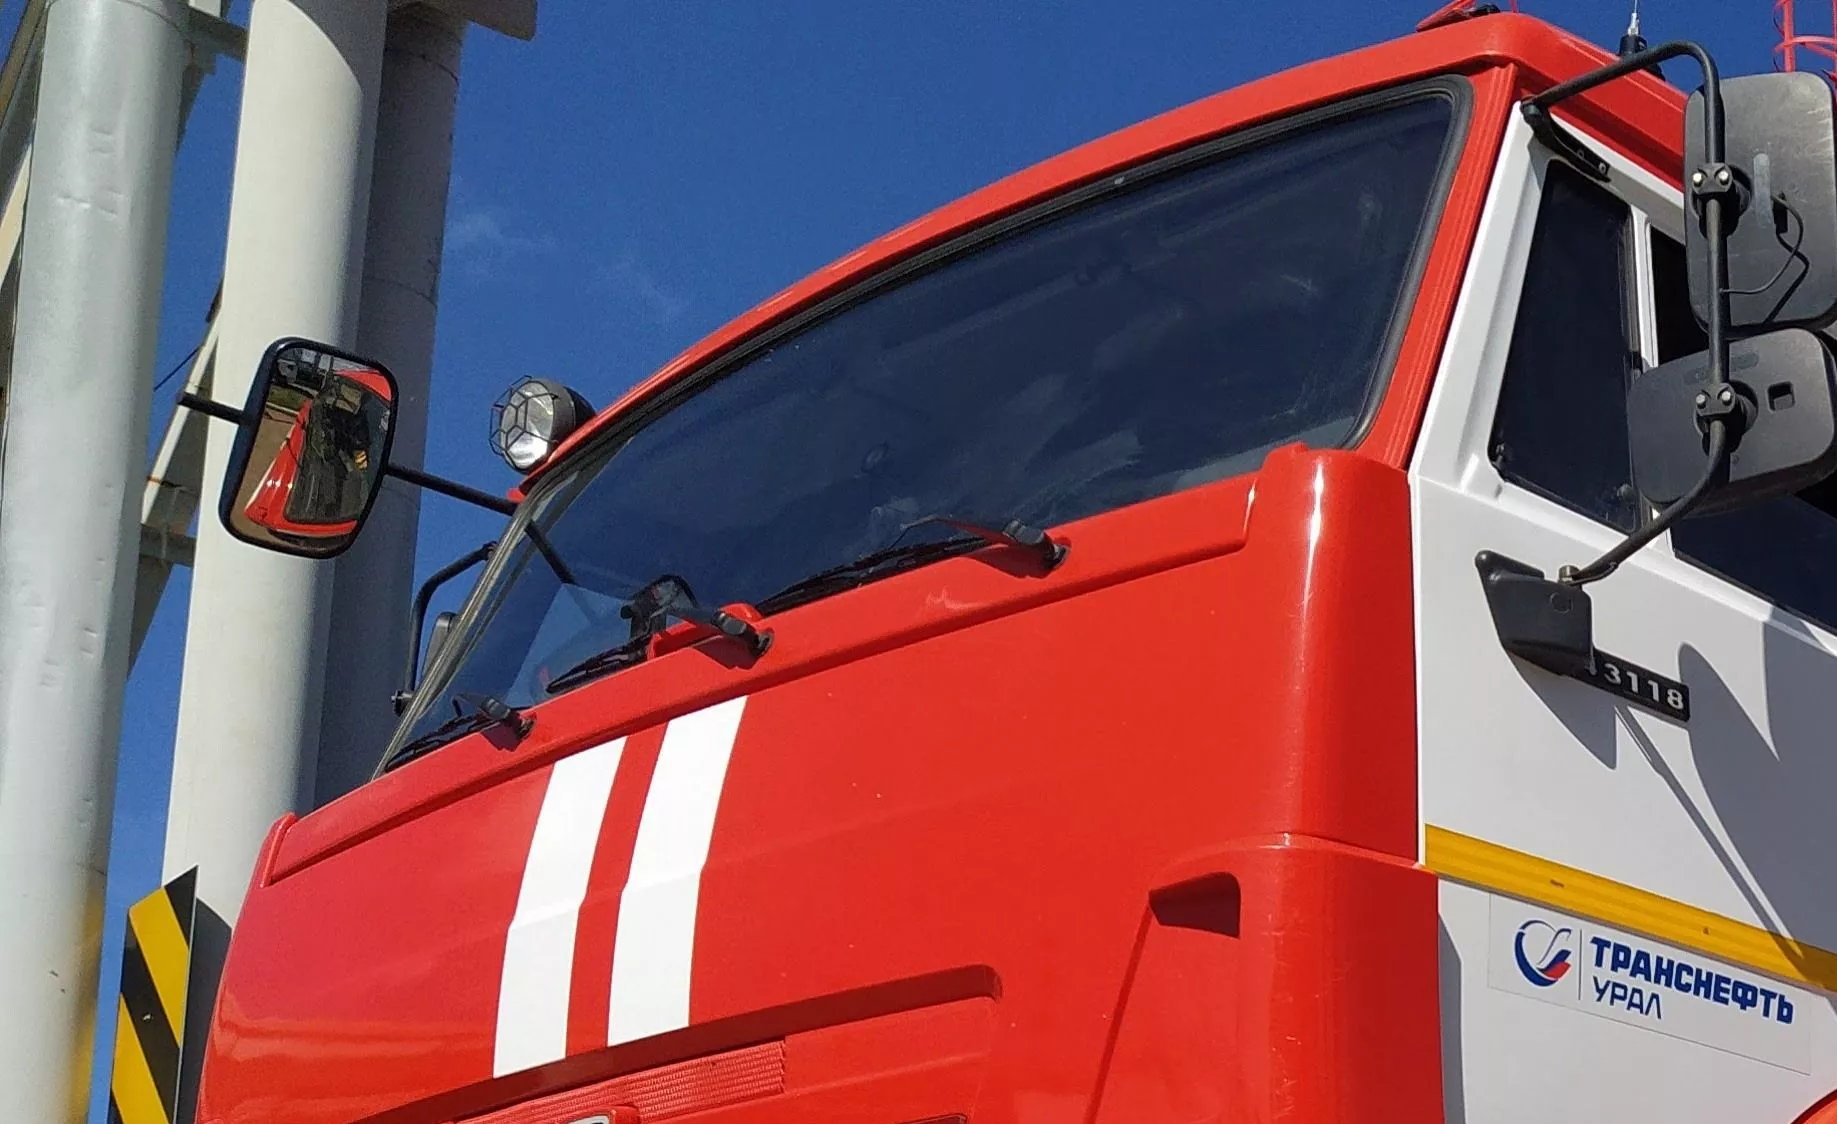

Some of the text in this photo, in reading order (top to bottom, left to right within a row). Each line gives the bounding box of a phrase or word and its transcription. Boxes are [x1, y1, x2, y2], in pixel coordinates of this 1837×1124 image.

[1604, 663, 1684, 709] 3118
[1590, 935, 1794, 1024] ТРАНСНЕФТЬ
[1592, 975, 1662, 1020] УРАЛ
